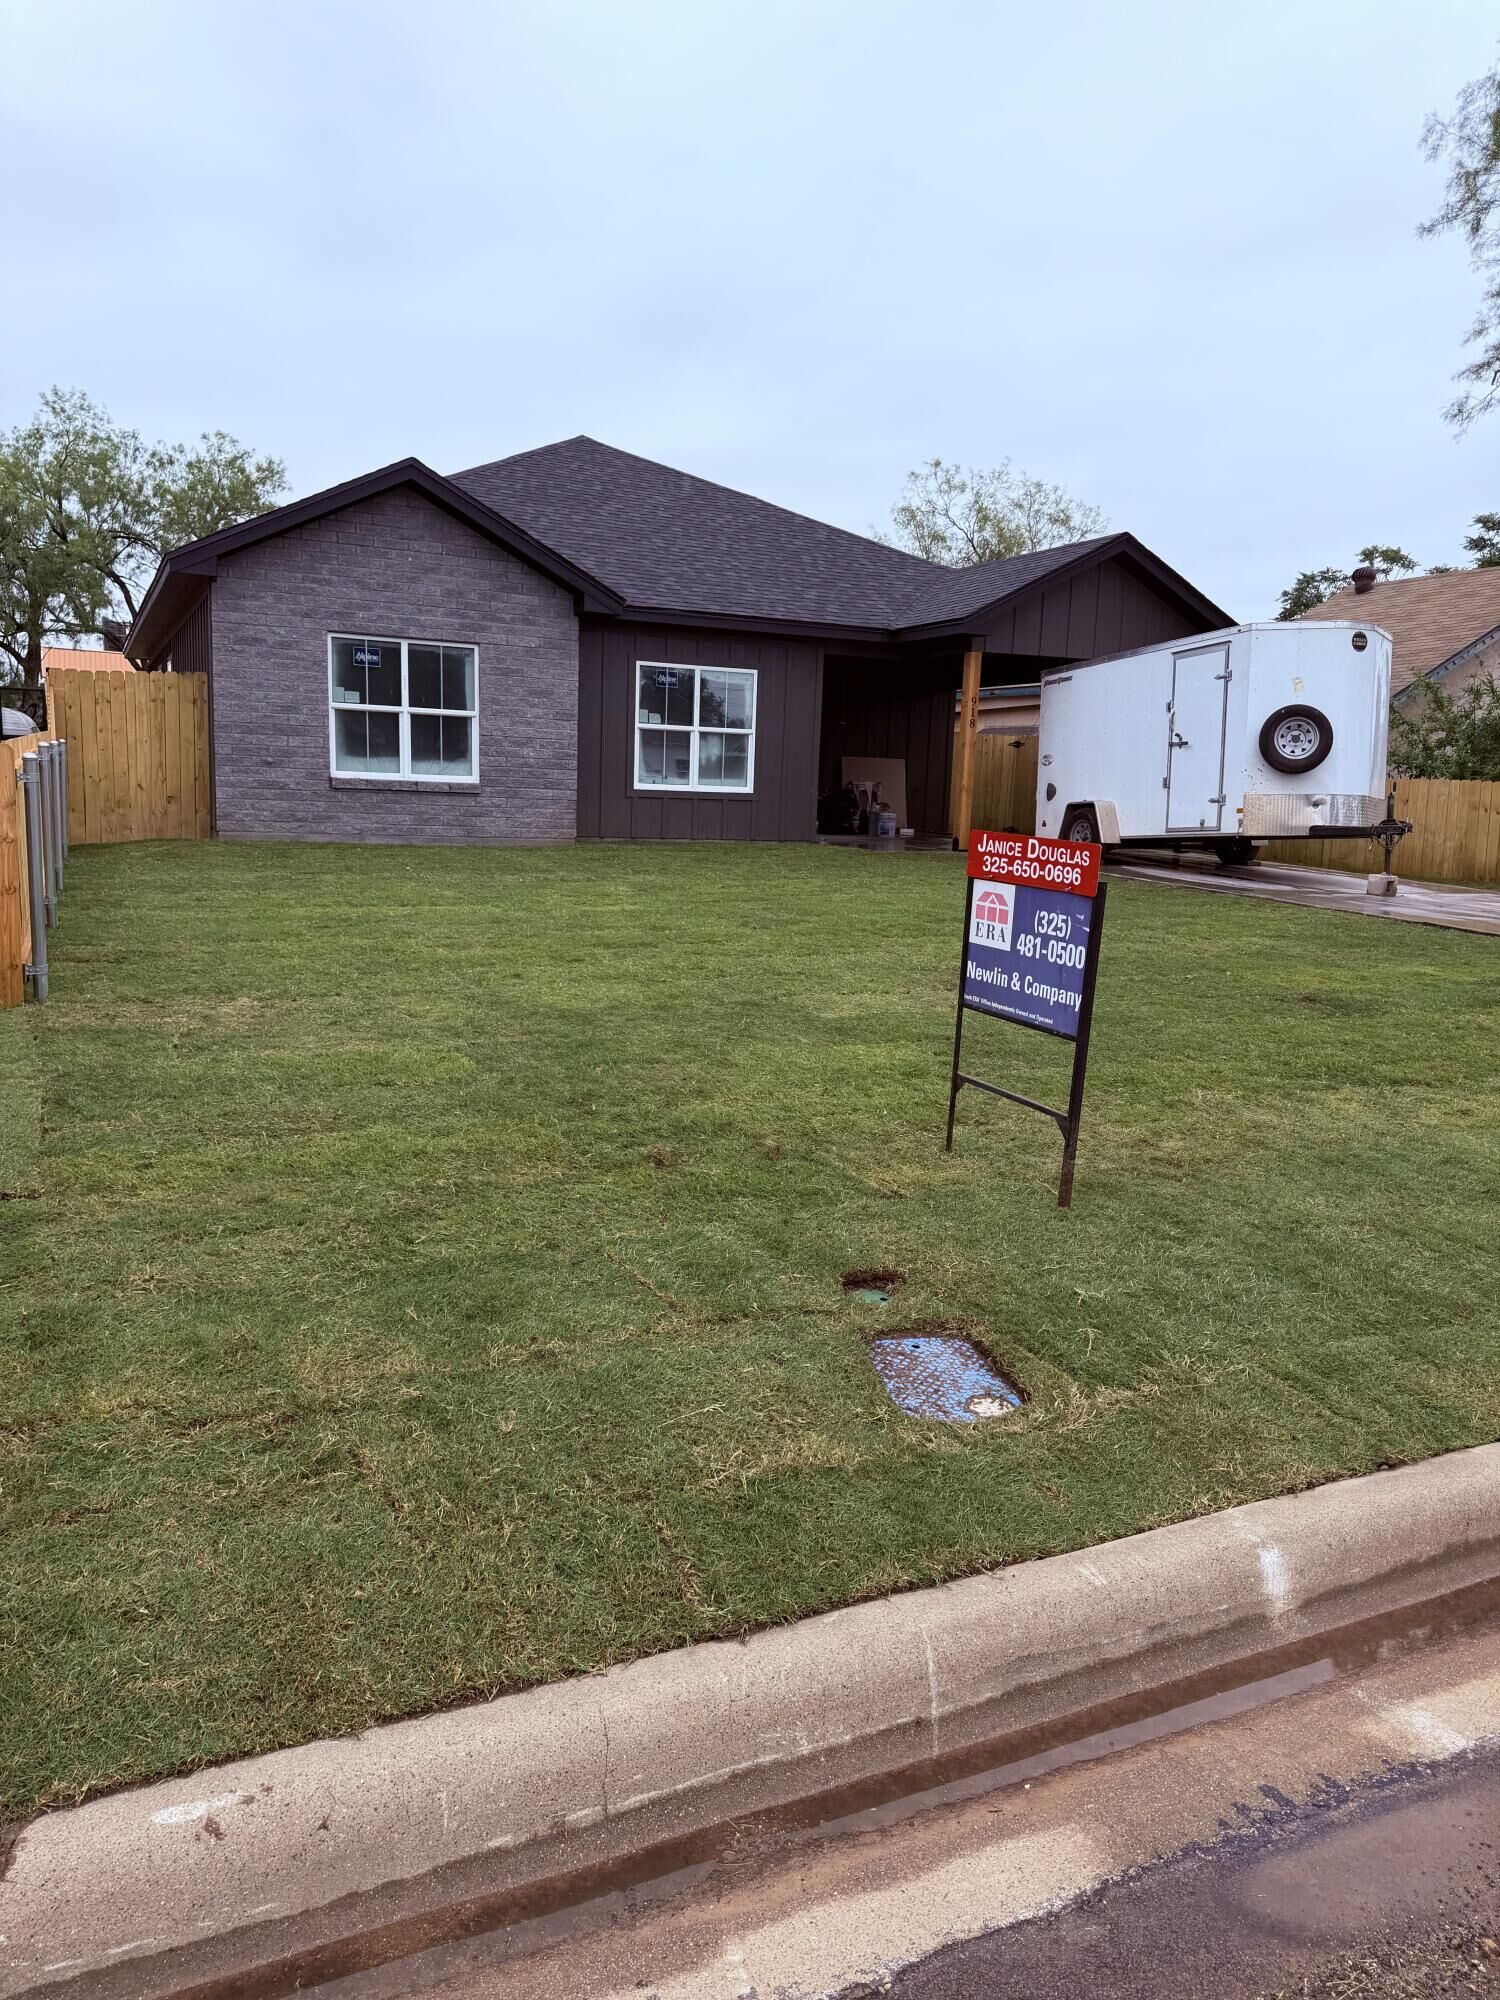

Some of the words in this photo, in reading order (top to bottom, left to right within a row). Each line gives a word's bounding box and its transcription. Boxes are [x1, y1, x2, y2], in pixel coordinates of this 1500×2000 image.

[977, 834, 1022, 857] JANICE
[1027, 839, 1090, 866] DOUGLAS
[982, 855, 1081, 885] 325-650-0696
[975, 921, 1007, 943] ERA
[1034, 910, 1071, 940] (325)
[1016, 933, 1086, 969] 481-0500
[966, 960, 1008, 988] Newlin
[1011, 972, 1021, 991] &
[1024, 975, 1083, 1011] Company
